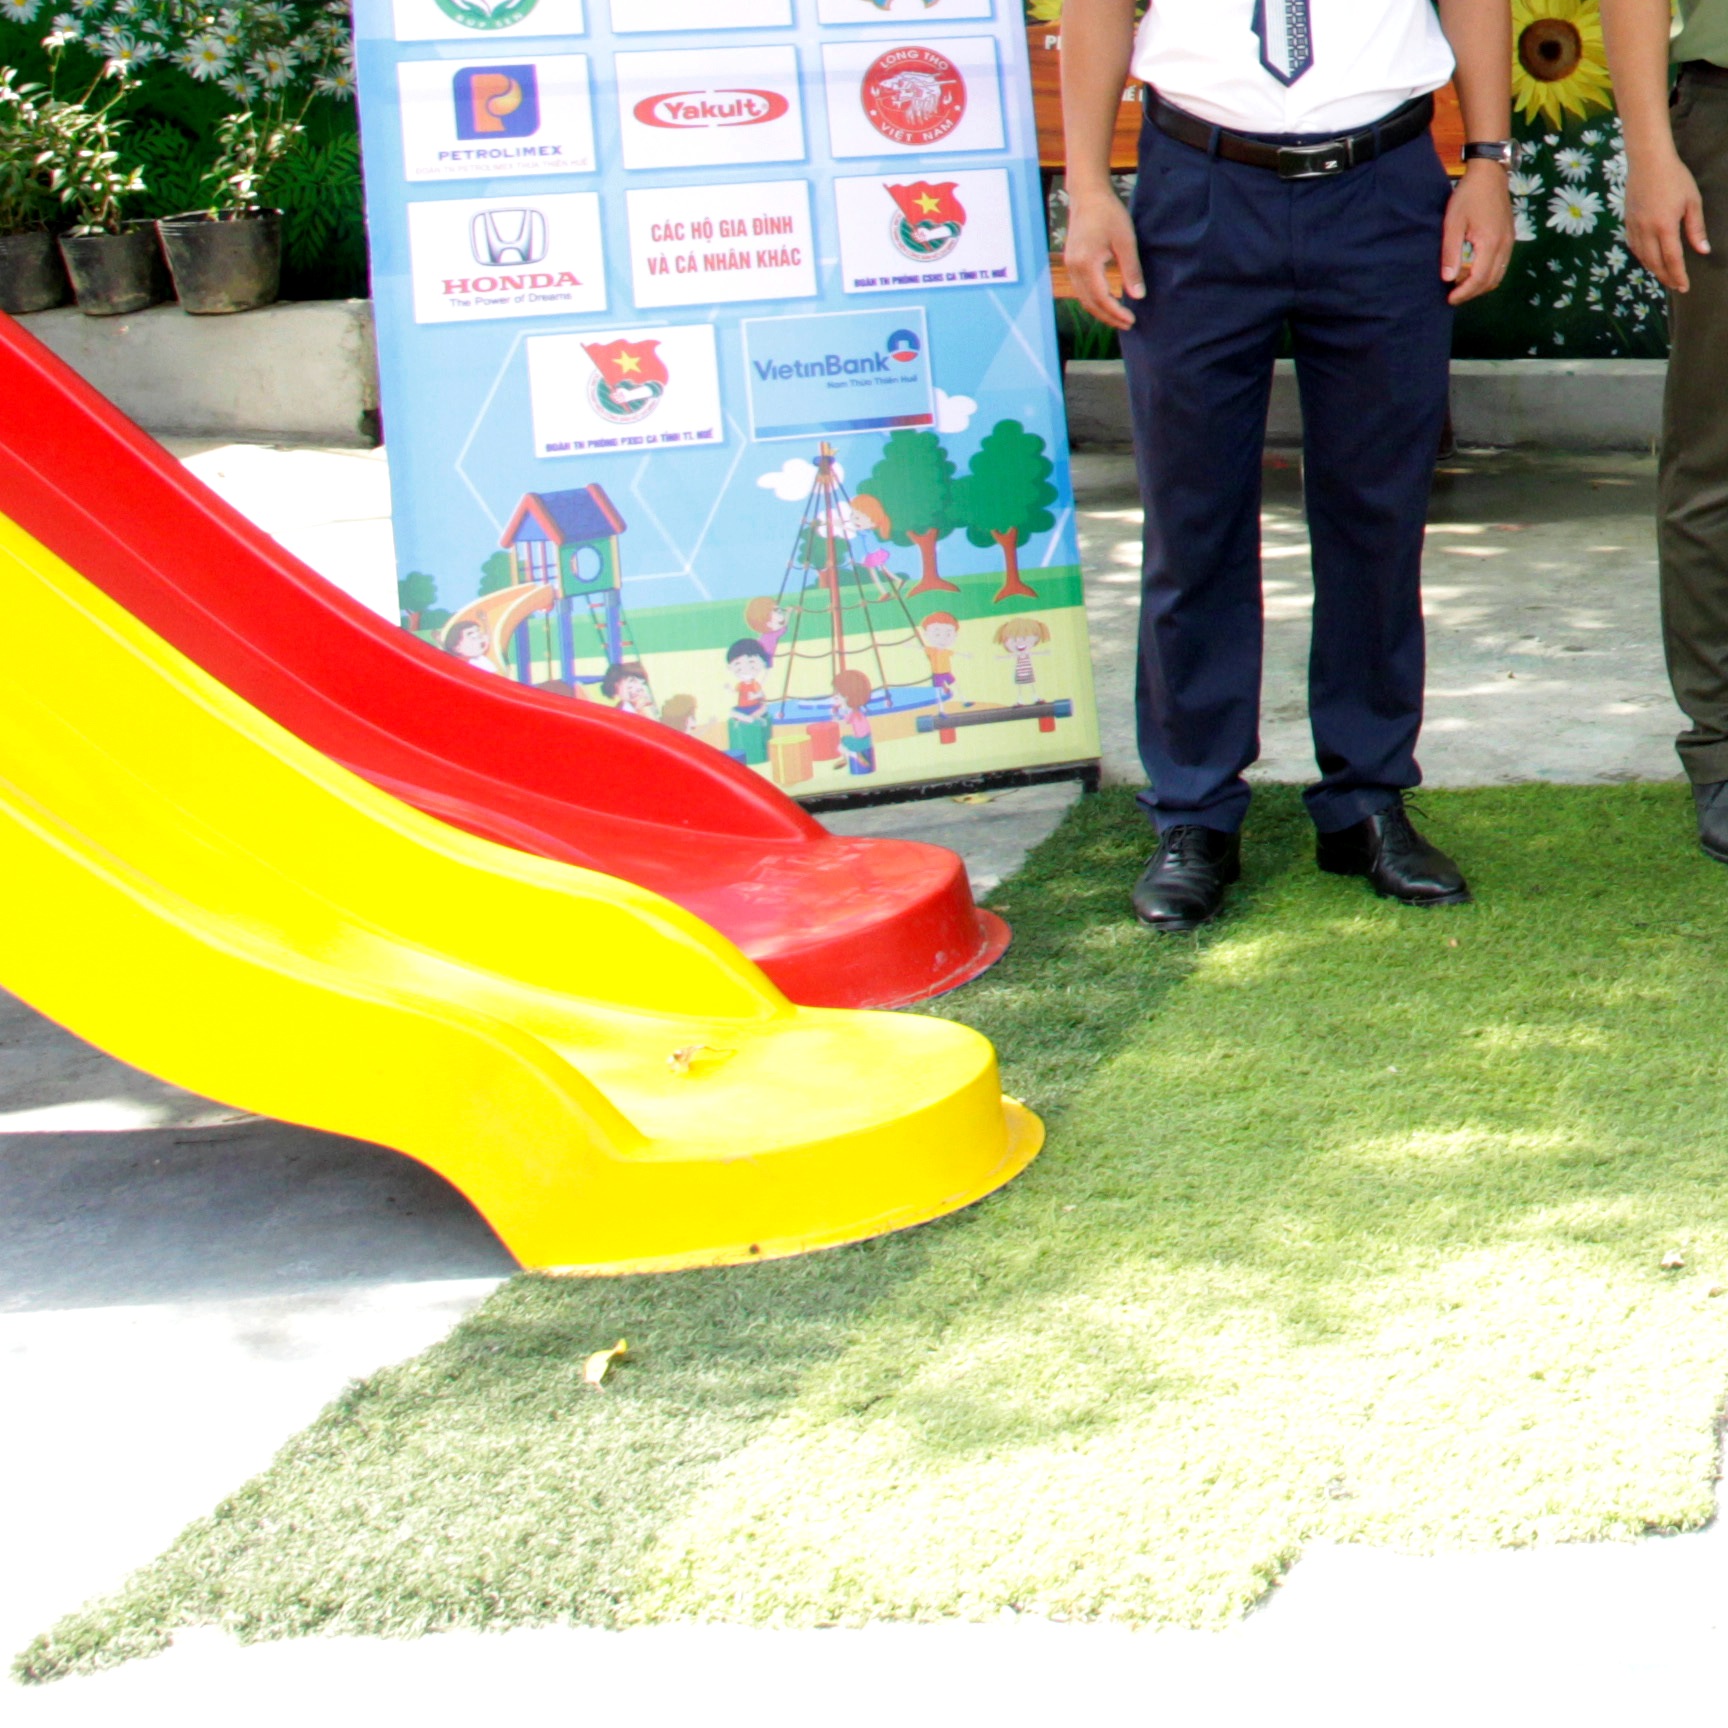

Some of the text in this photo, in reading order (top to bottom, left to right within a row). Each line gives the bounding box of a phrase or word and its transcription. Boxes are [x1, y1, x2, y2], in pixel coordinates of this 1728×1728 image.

[880, 50, 919, 68] LONG
[663, 99, 762, 120] Yakult
[923, 119, 954, 141] NAM
[438, 145, 562, 161] PETROLIMEX
[651, 213, 793, 243] CÁC HỘ GIA ĐÌNH
[647, 244, 801, 275] VÀ CÁ NHÂN KHÁC
[442, 271, 583, 294] HONDA
[450, 292, 572, 307] The Power of Dreams
[753, 351, 890, 381] VietinBank
